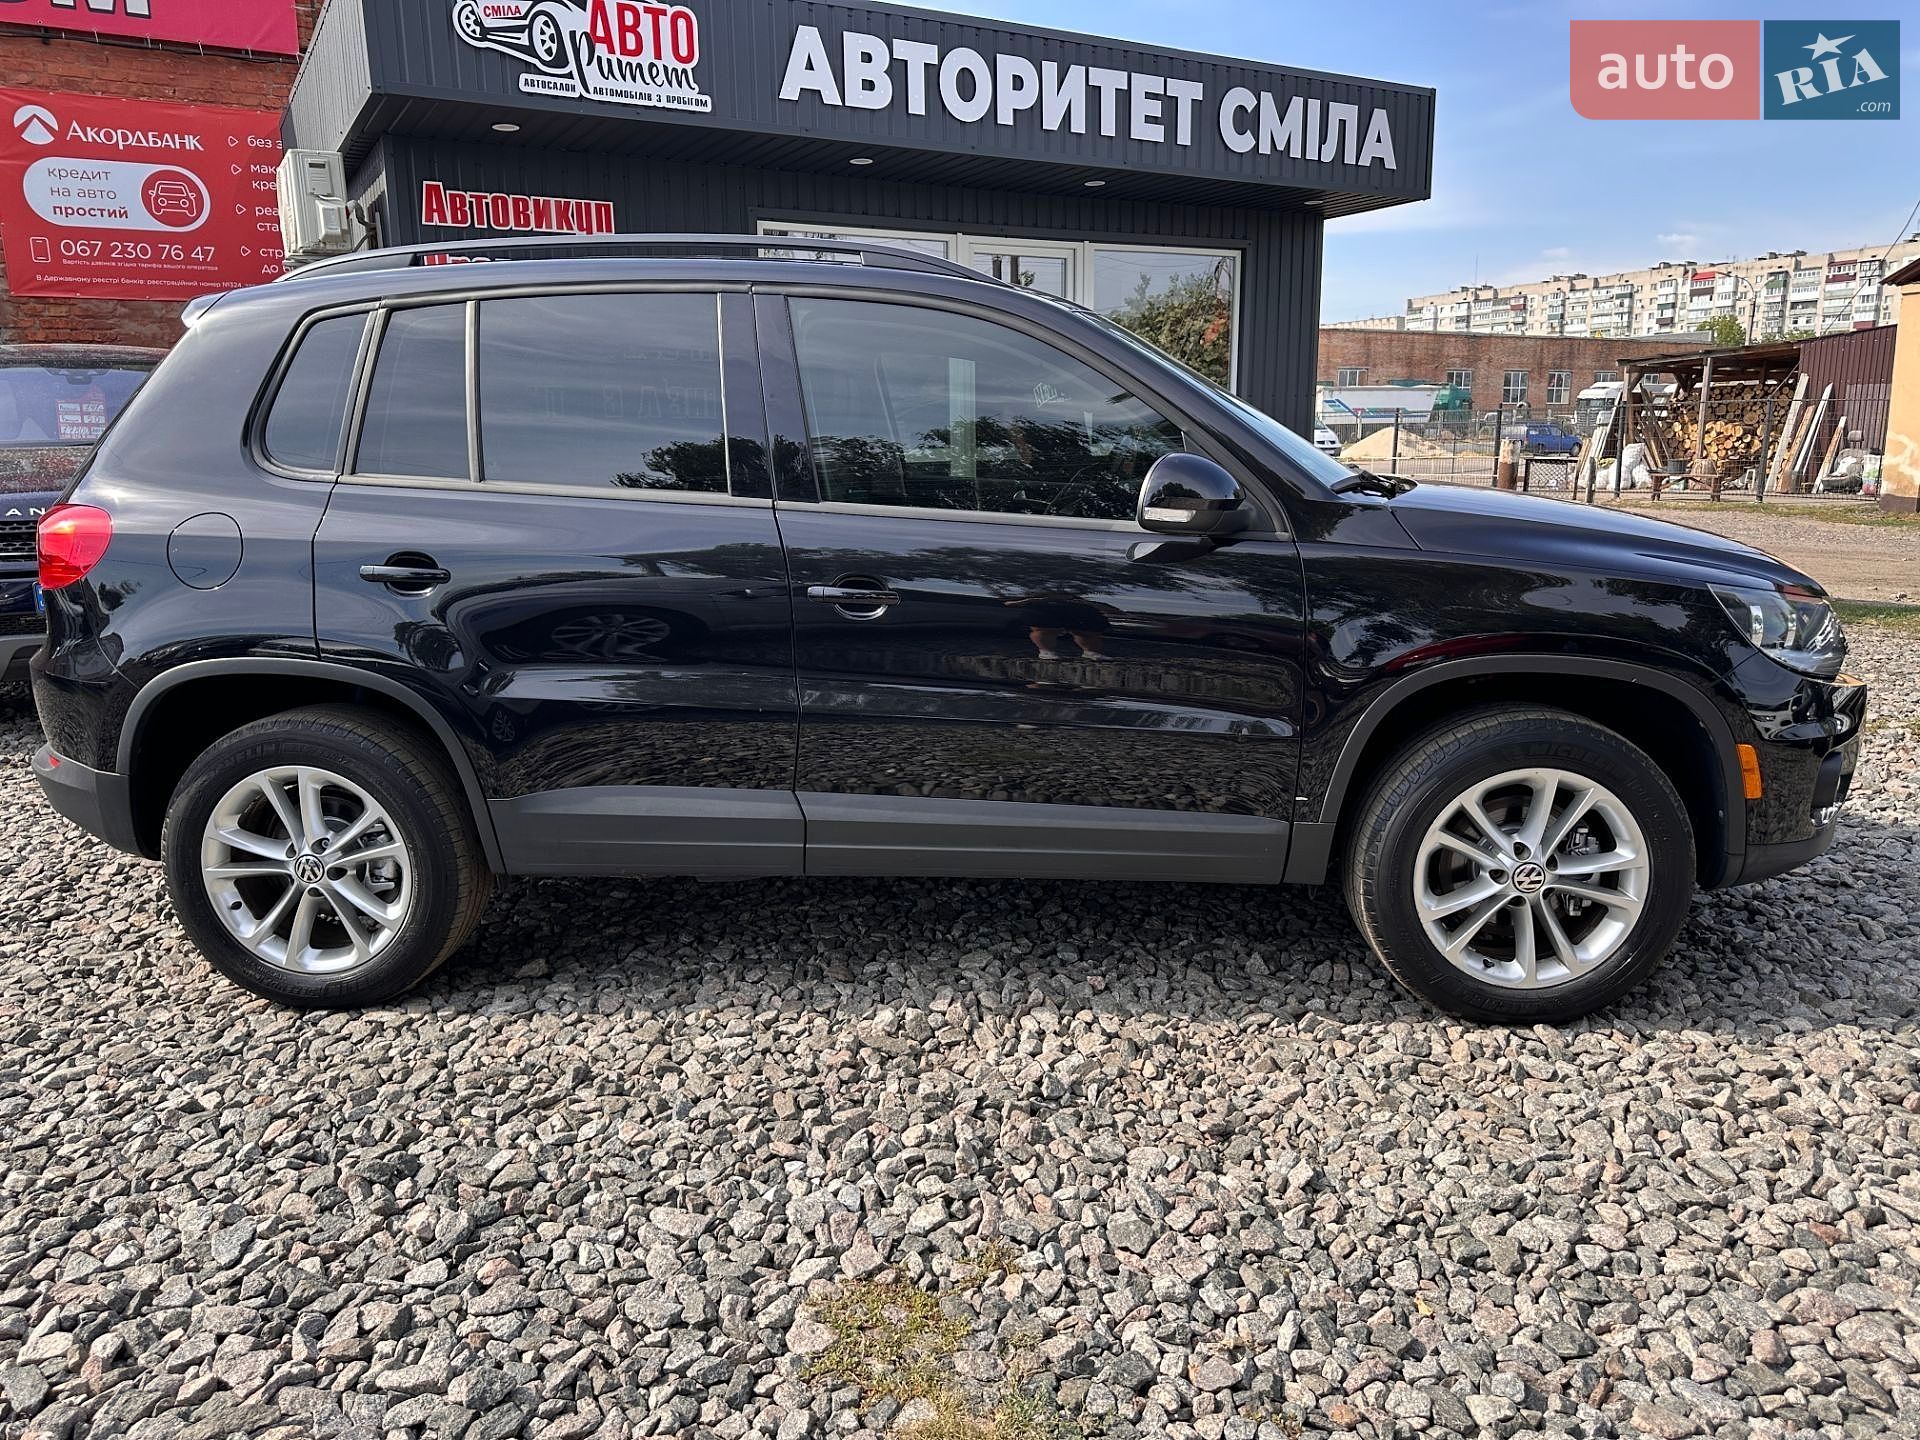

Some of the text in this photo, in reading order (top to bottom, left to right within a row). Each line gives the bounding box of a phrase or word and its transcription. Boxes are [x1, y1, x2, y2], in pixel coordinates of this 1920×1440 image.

[483, 4, 522, 18] СМІЛА
[589, 0, 696, 65] АВТО
[523, 78, 576, 93] АВТОСАЛОН
[592, 86, 653, 102] АВТОМОБІЛІВ
[666, 95, 708, 108] ПРОБІГОМ
[778, 24, 1397, 170] АВТОРИТЕТ СМІЛА
[247, 135, 272, 148] без
[47, 167, 111, 181] кредит
[250, 164, 276, 174] мак
[252, 180, 277, 191] кре
[50, 186, 117, 200] на авто
[53, 204, 129, 219] простий
[255, 206, 279, 217] реа
[256, 222, 280, 232] ста
[60, 239, 215, 262] 067 230 76 47
[260, 248, 284, 260] стр
[261, 264, 279, 275] до
